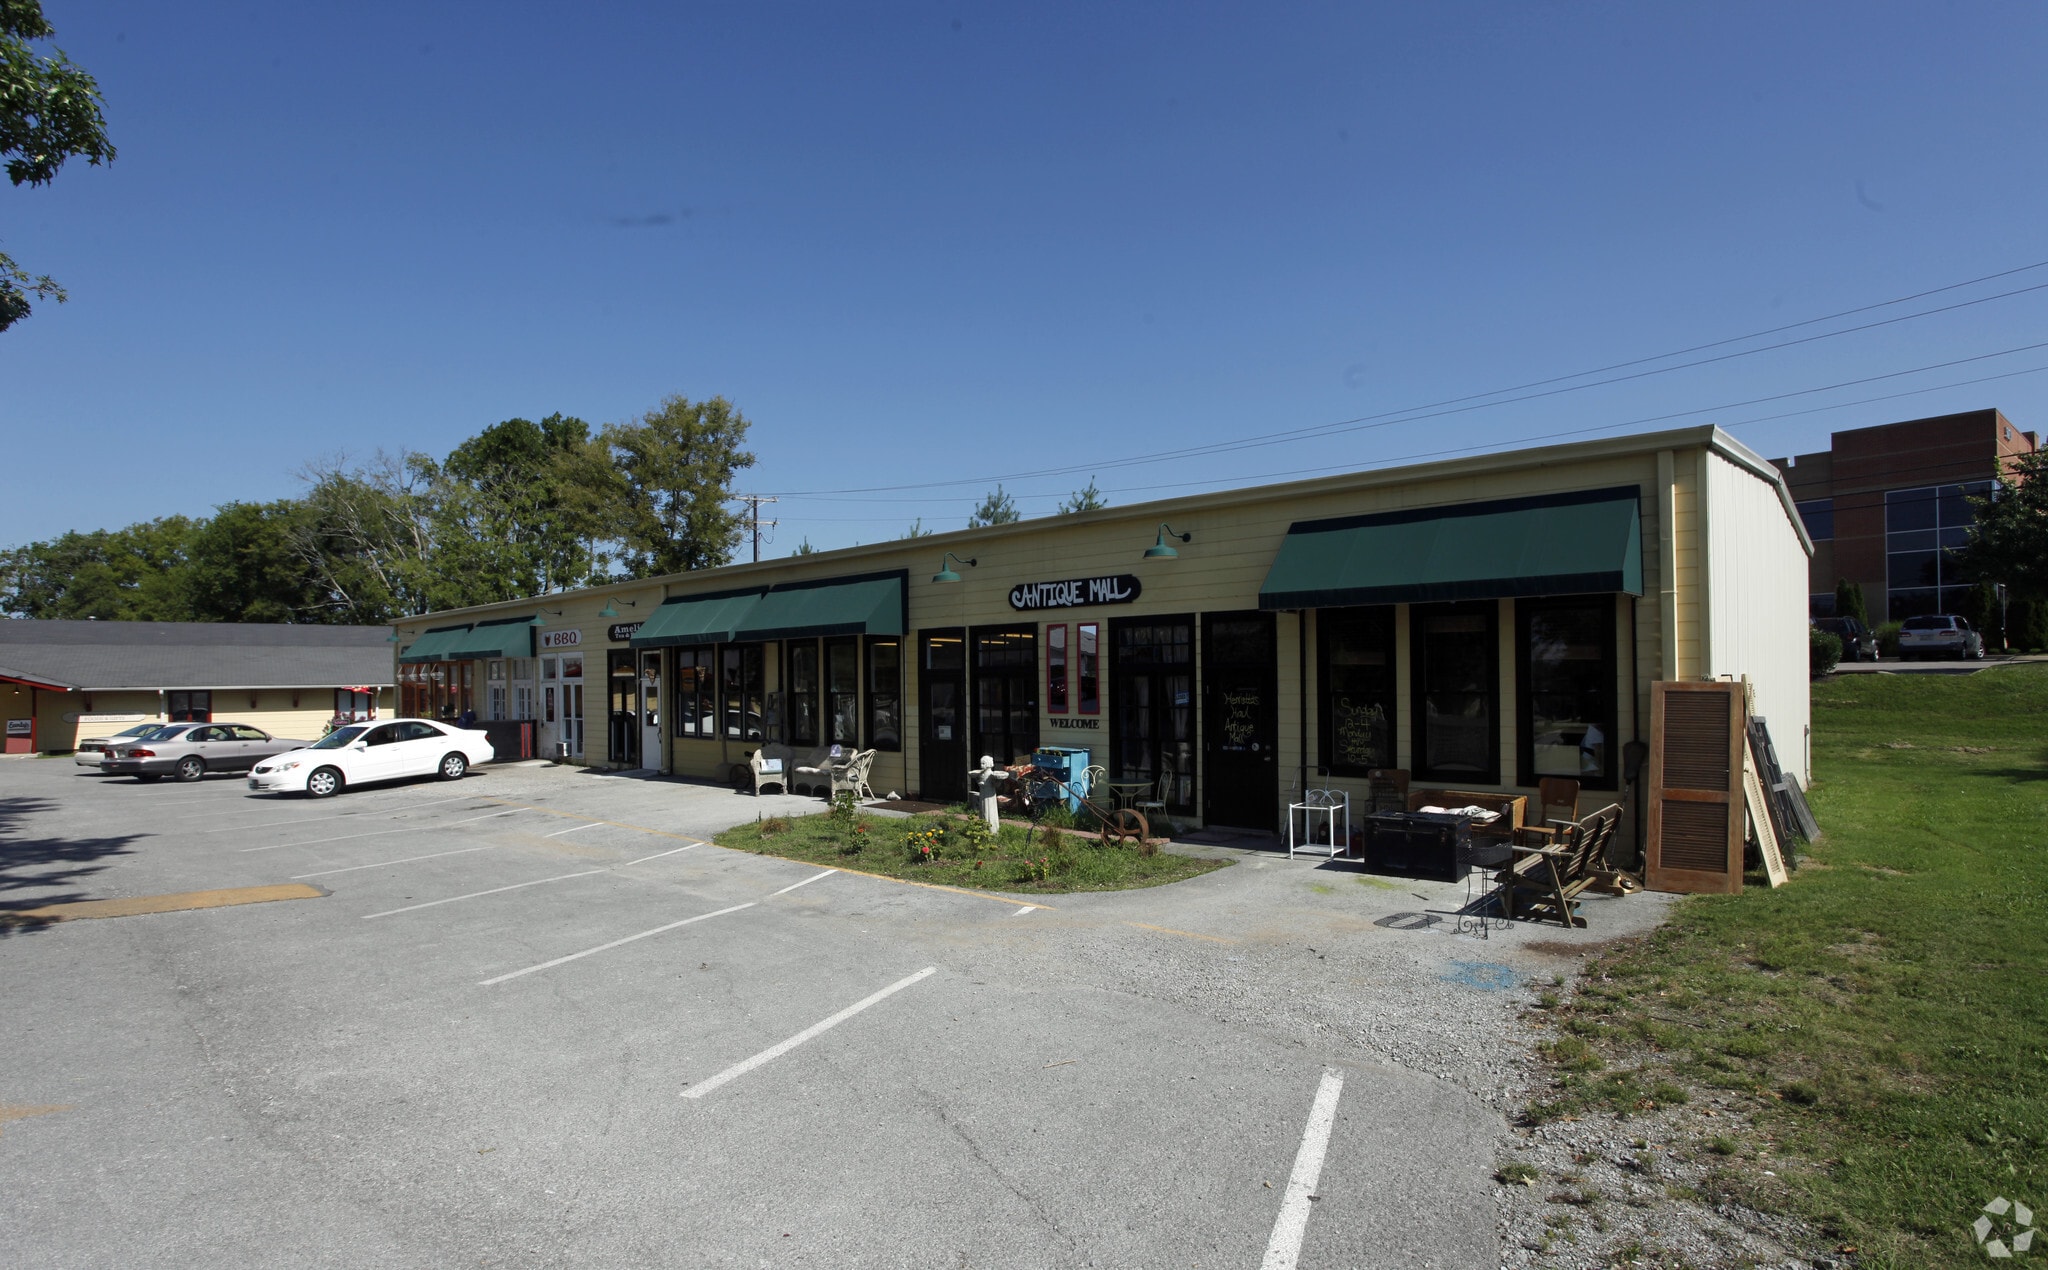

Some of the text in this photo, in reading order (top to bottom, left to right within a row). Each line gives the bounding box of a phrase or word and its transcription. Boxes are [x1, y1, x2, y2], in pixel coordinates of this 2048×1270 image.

[1011, 577, 1131, 608] ANTIQUE MALL
[554, 631, 577, 645] BBQ
[1338, 697, 1378, 717] Sunday
[1050, 718, 1099, 729] WELCOME
